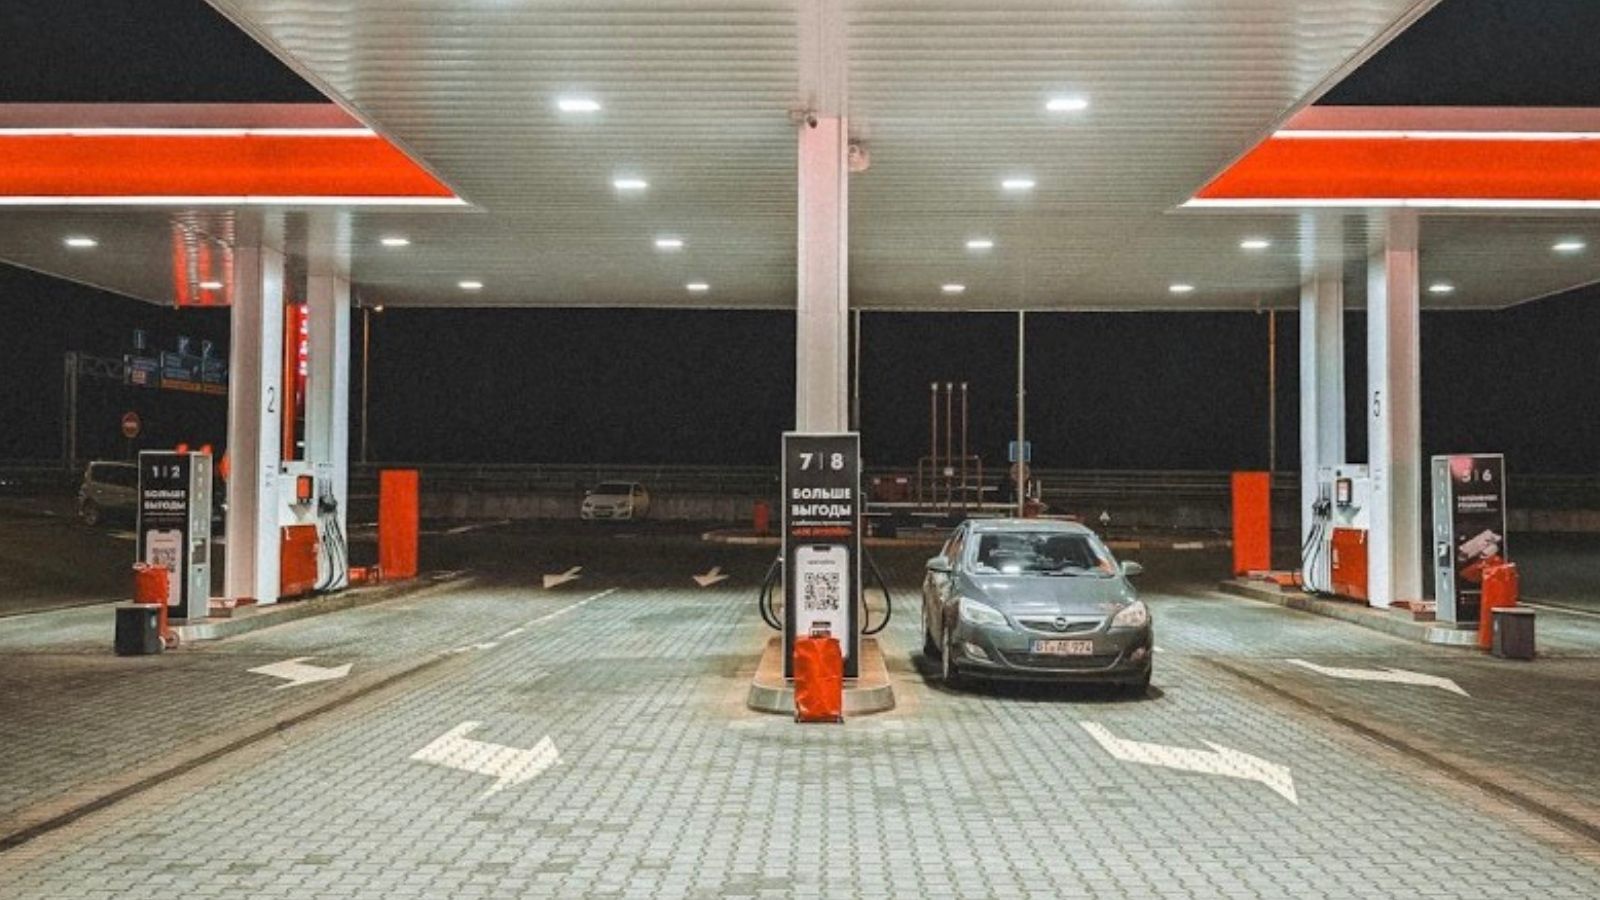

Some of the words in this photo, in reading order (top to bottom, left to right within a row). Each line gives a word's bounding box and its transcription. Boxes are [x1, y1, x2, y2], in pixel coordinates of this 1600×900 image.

[267, 386, 275, 413] 2
[1373, 390, 1381, 417] 5
[799, 452, 814, 470] 7
[830, 452, 844, 470] 8
[171, 465, 180, 478] 2
[1481, 469, 1492, 482] 6
[792, 488, 851, 499] БОЛЬШЕ
[792, 504, 852, 517] ВЫГОДЫ
